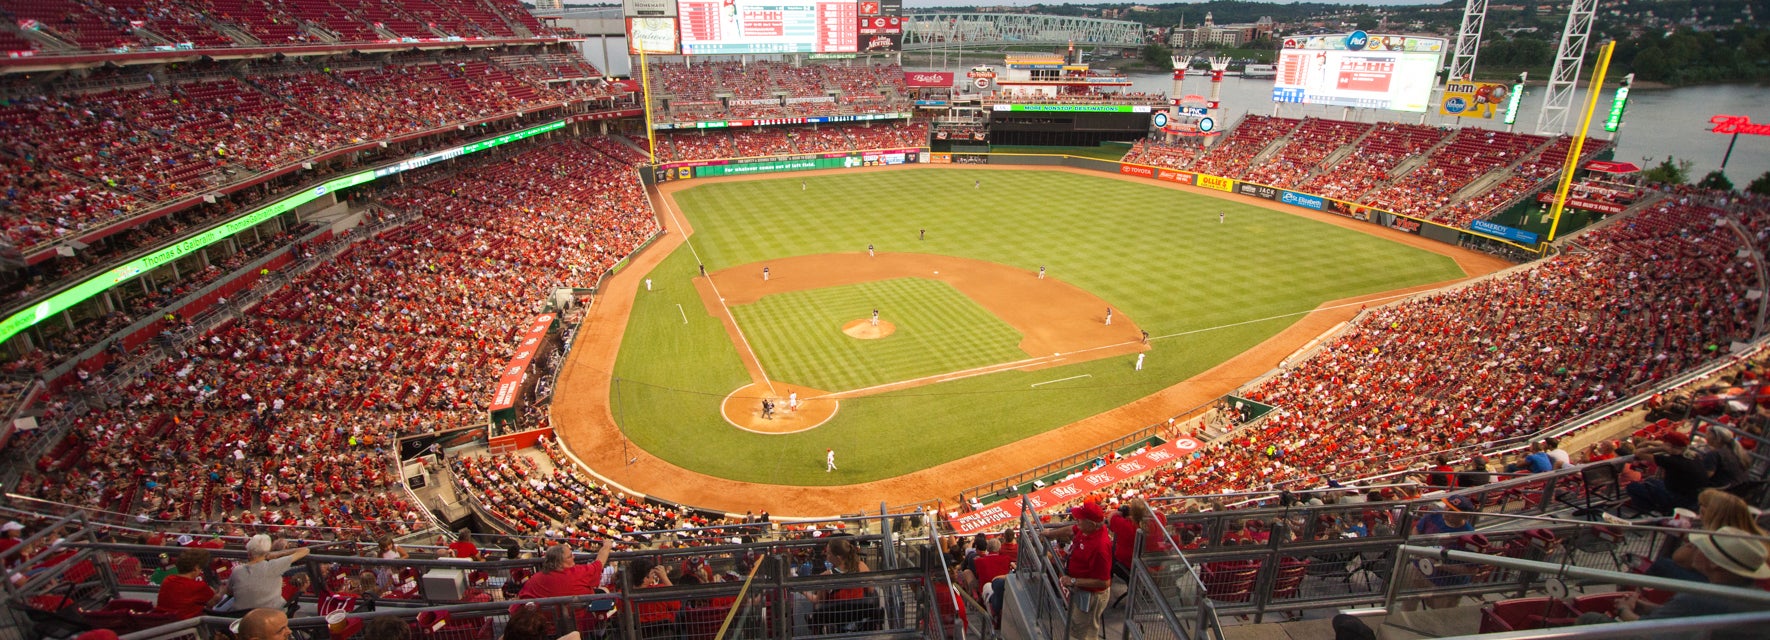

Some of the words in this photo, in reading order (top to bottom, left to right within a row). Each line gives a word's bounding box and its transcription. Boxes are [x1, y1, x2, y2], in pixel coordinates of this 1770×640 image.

[1131, 166, 1152, 176] TOYOTA
[142, 248, 175, 268] Thomas
[960, 510, 1012, 533] CHAMPIONS
